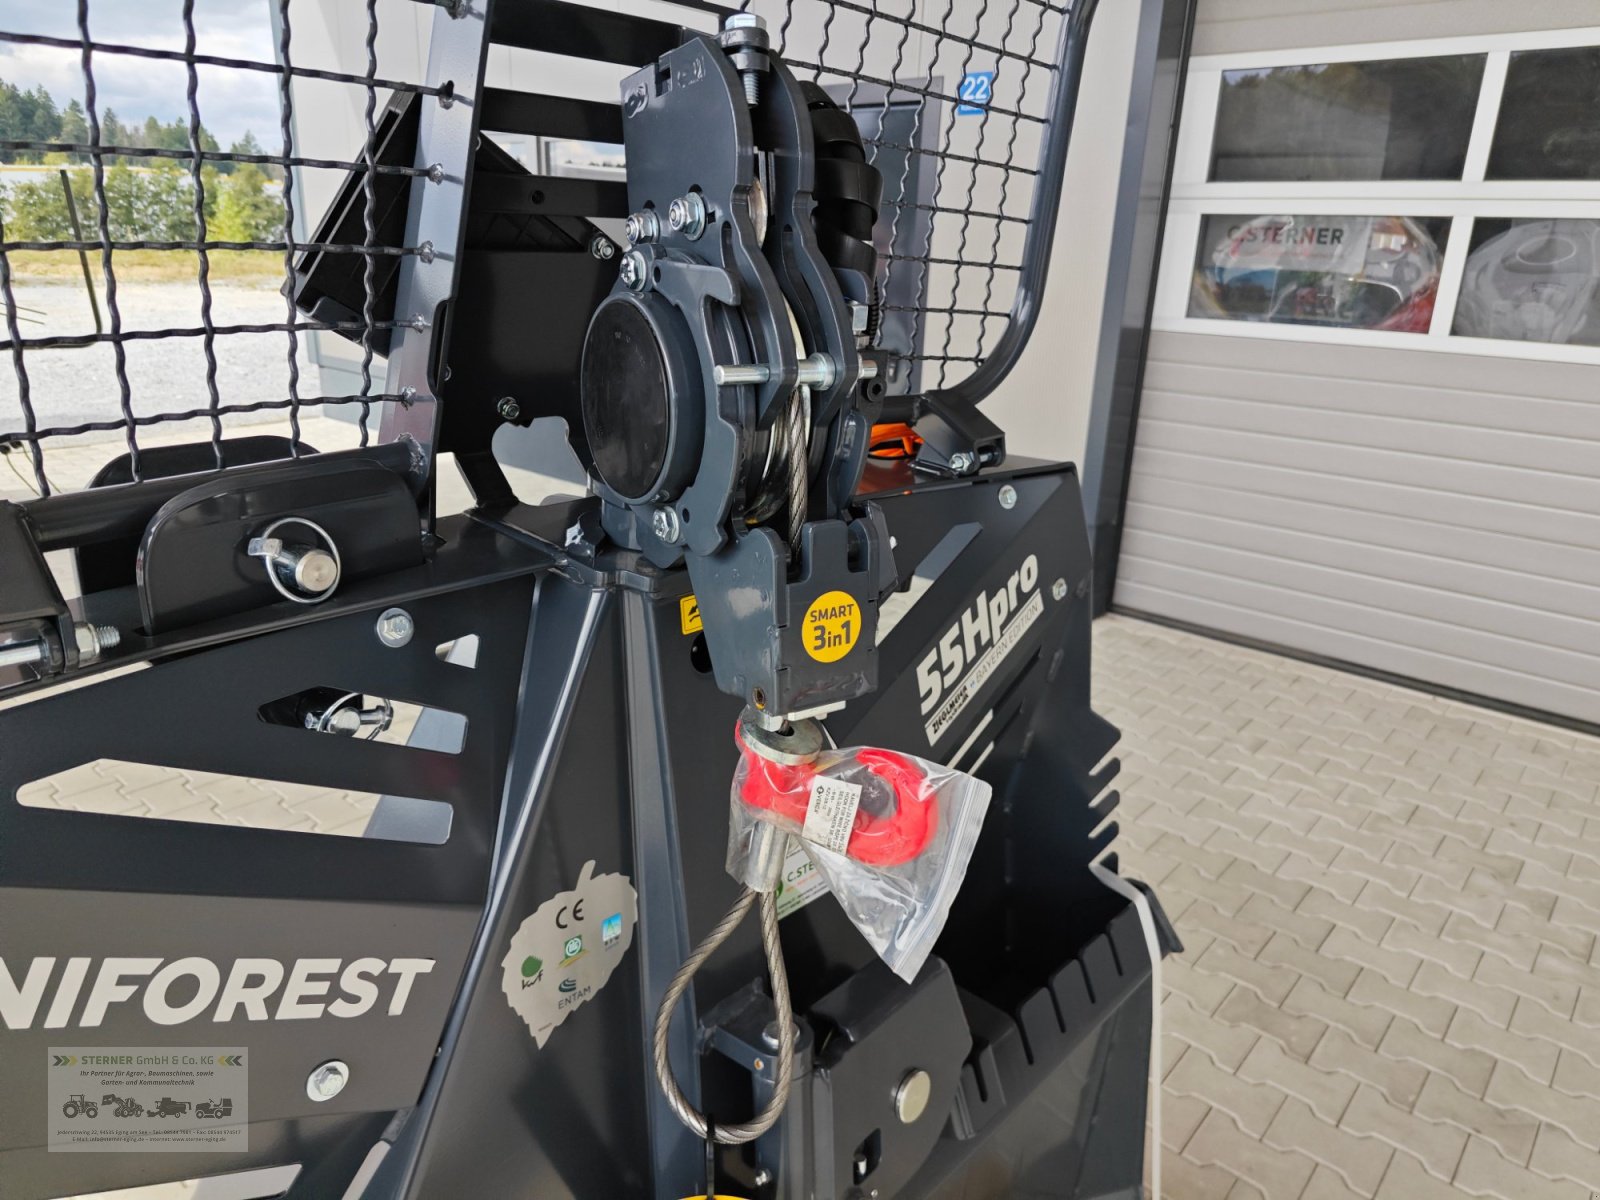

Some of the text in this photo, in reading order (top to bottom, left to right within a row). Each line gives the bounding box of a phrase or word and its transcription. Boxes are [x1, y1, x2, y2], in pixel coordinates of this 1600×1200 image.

[963, 76, 988, 100] 22
[810, 604, 854, 623] SMART
[813, 620, 851, 651] 3in1
[916, 554, 1038, 716] 55Hpro
[976, 639, 1009, 684] BAYERN
[1008, 603, 1039, 645] EDITION
[787, 861, 815, 882] C.STE
[558, 985, 592, 1010] ENTAM
